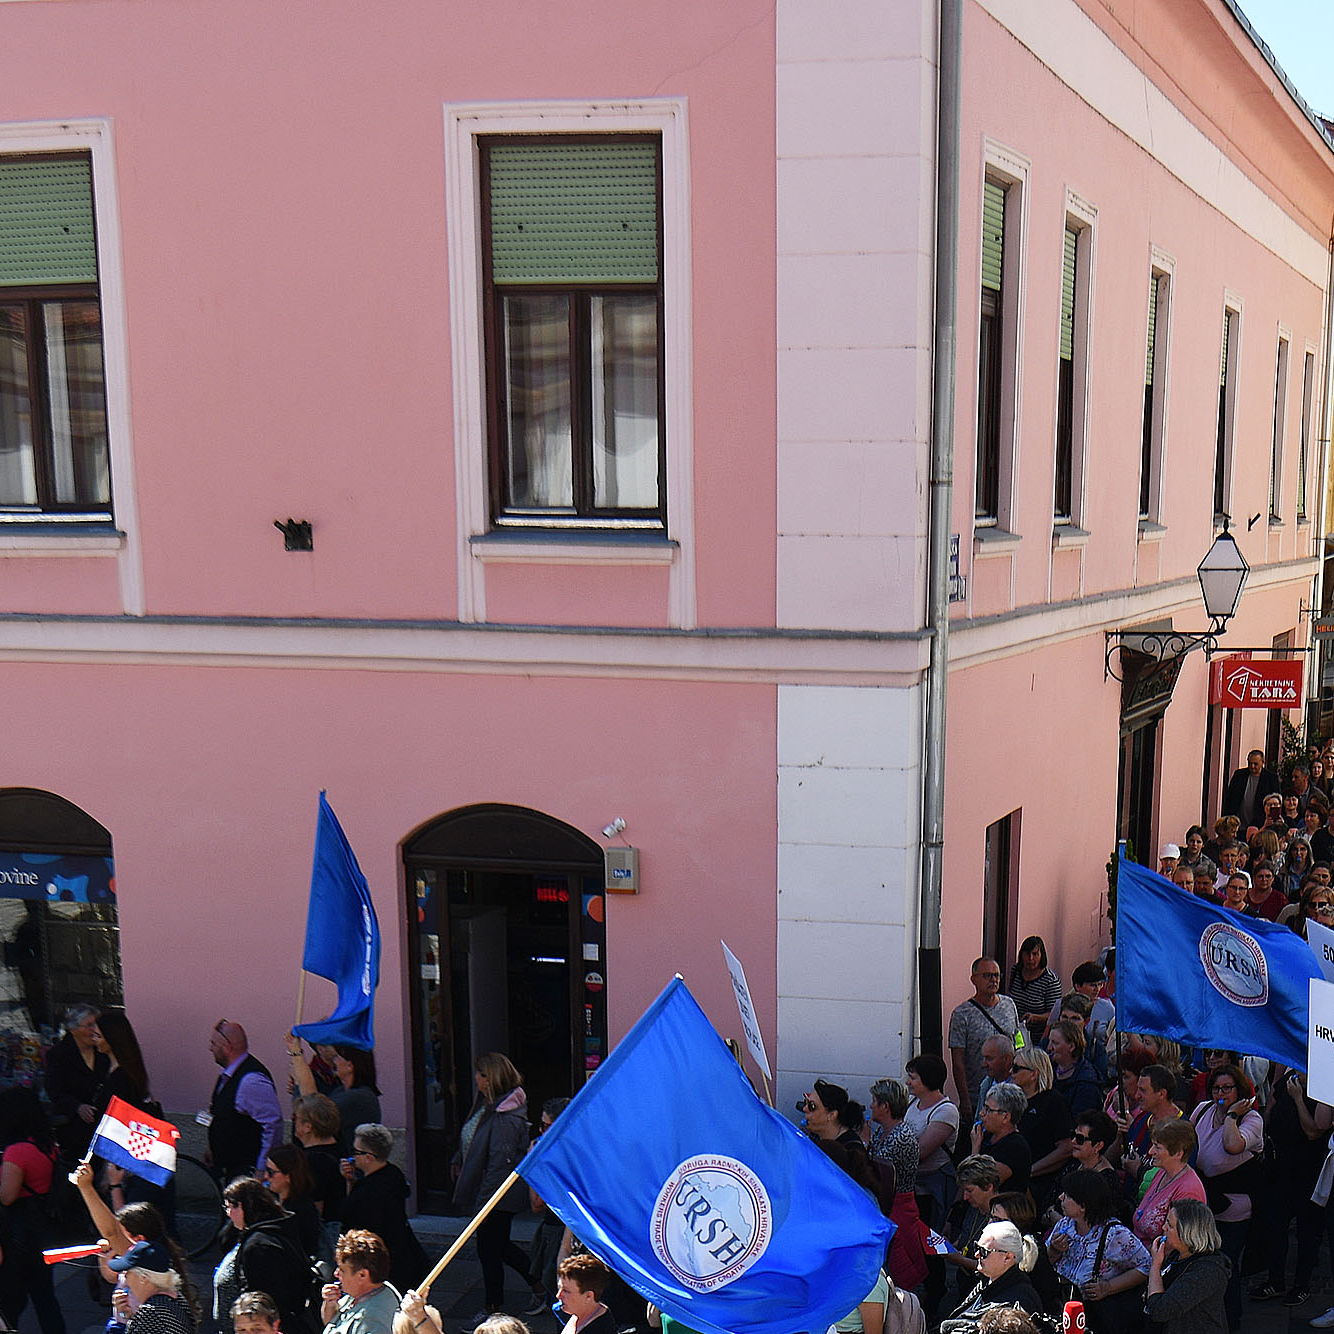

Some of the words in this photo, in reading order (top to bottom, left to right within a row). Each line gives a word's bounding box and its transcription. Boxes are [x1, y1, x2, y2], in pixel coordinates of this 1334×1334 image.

[1250, 687, 1297, 699] TARA
[748, 1177, 767, 1215] SINDIKATA
[676, 1179, 746, 1265] URSH
[751, 1216, 768, 1257] HRVATSKE
[717, 1263, 746, 1282] CROATIA
